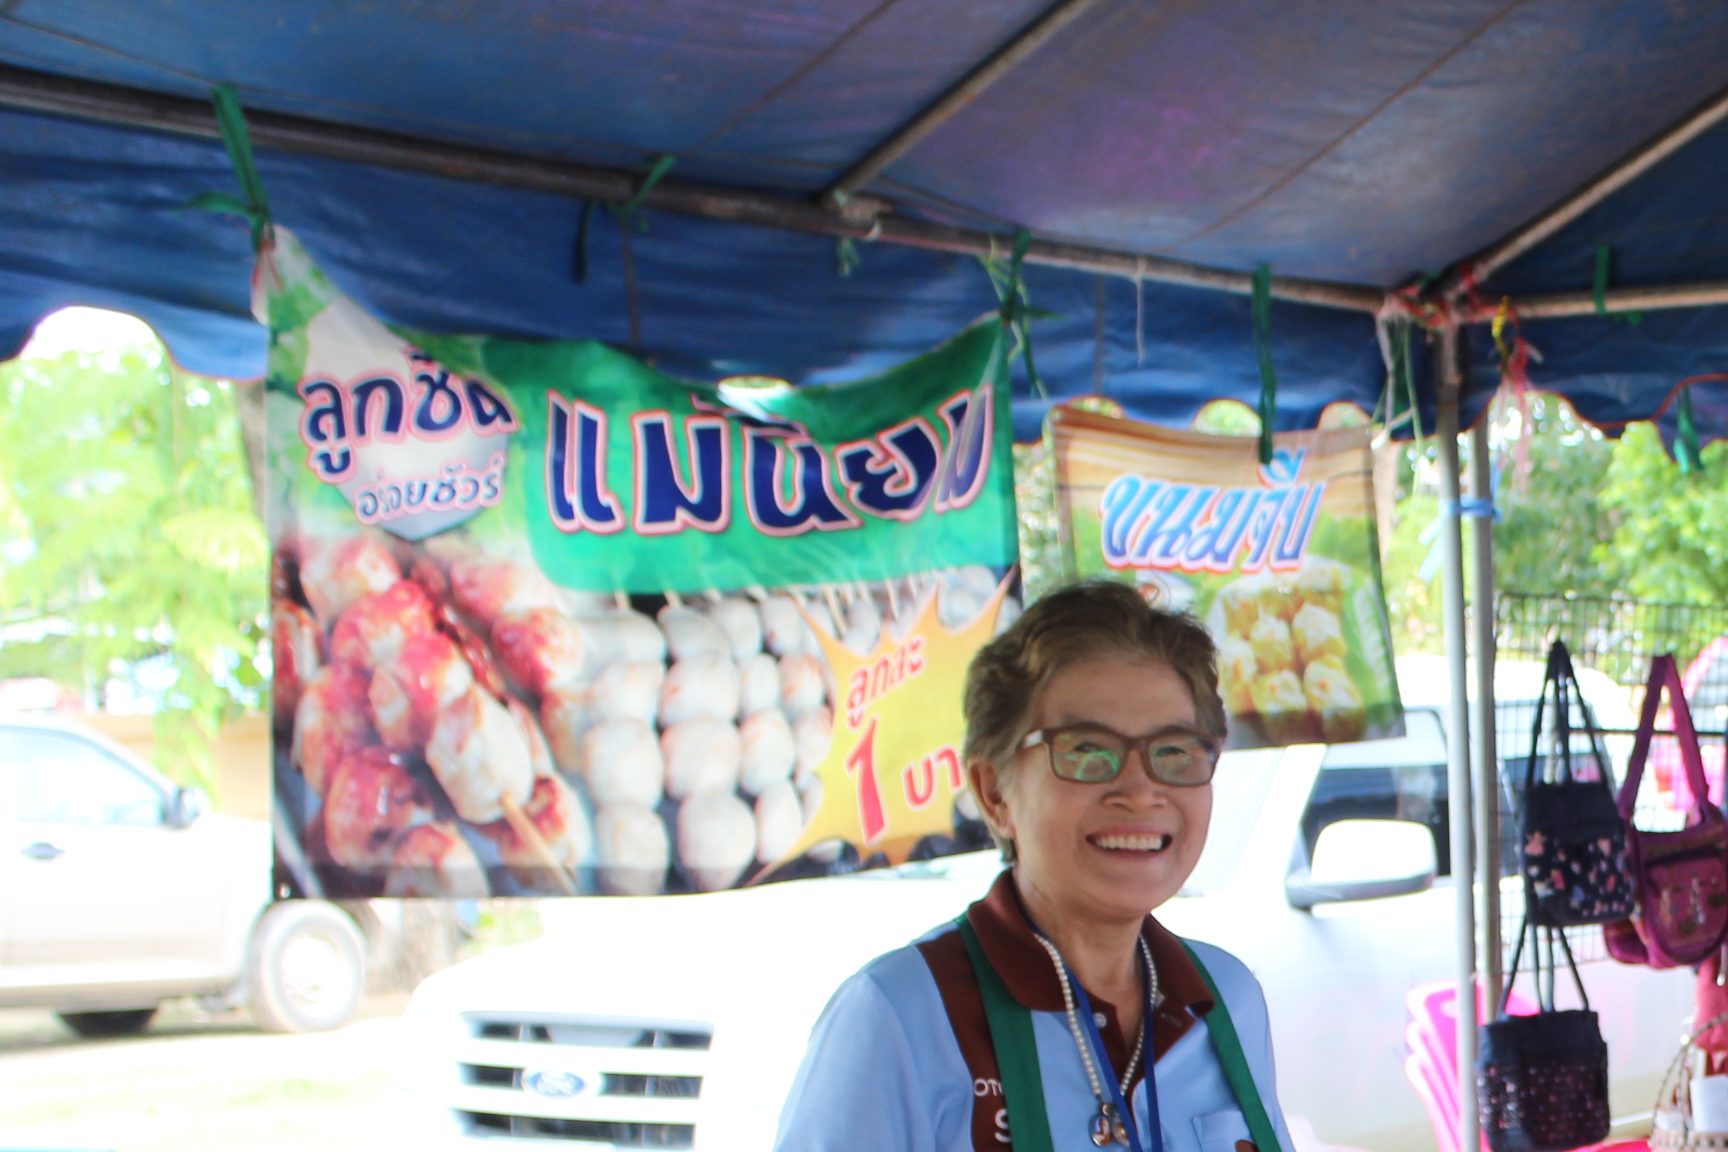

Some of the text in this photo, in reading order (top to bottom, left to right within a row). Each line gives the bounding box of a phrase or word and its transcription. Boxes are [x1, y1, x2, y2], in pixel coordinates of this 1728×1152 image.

[1101, 449, 1326, 572] ขนมจีบ
[848, 638, 923, 728] ลูกละ
[847, 716, 962, 844] 1 บา
